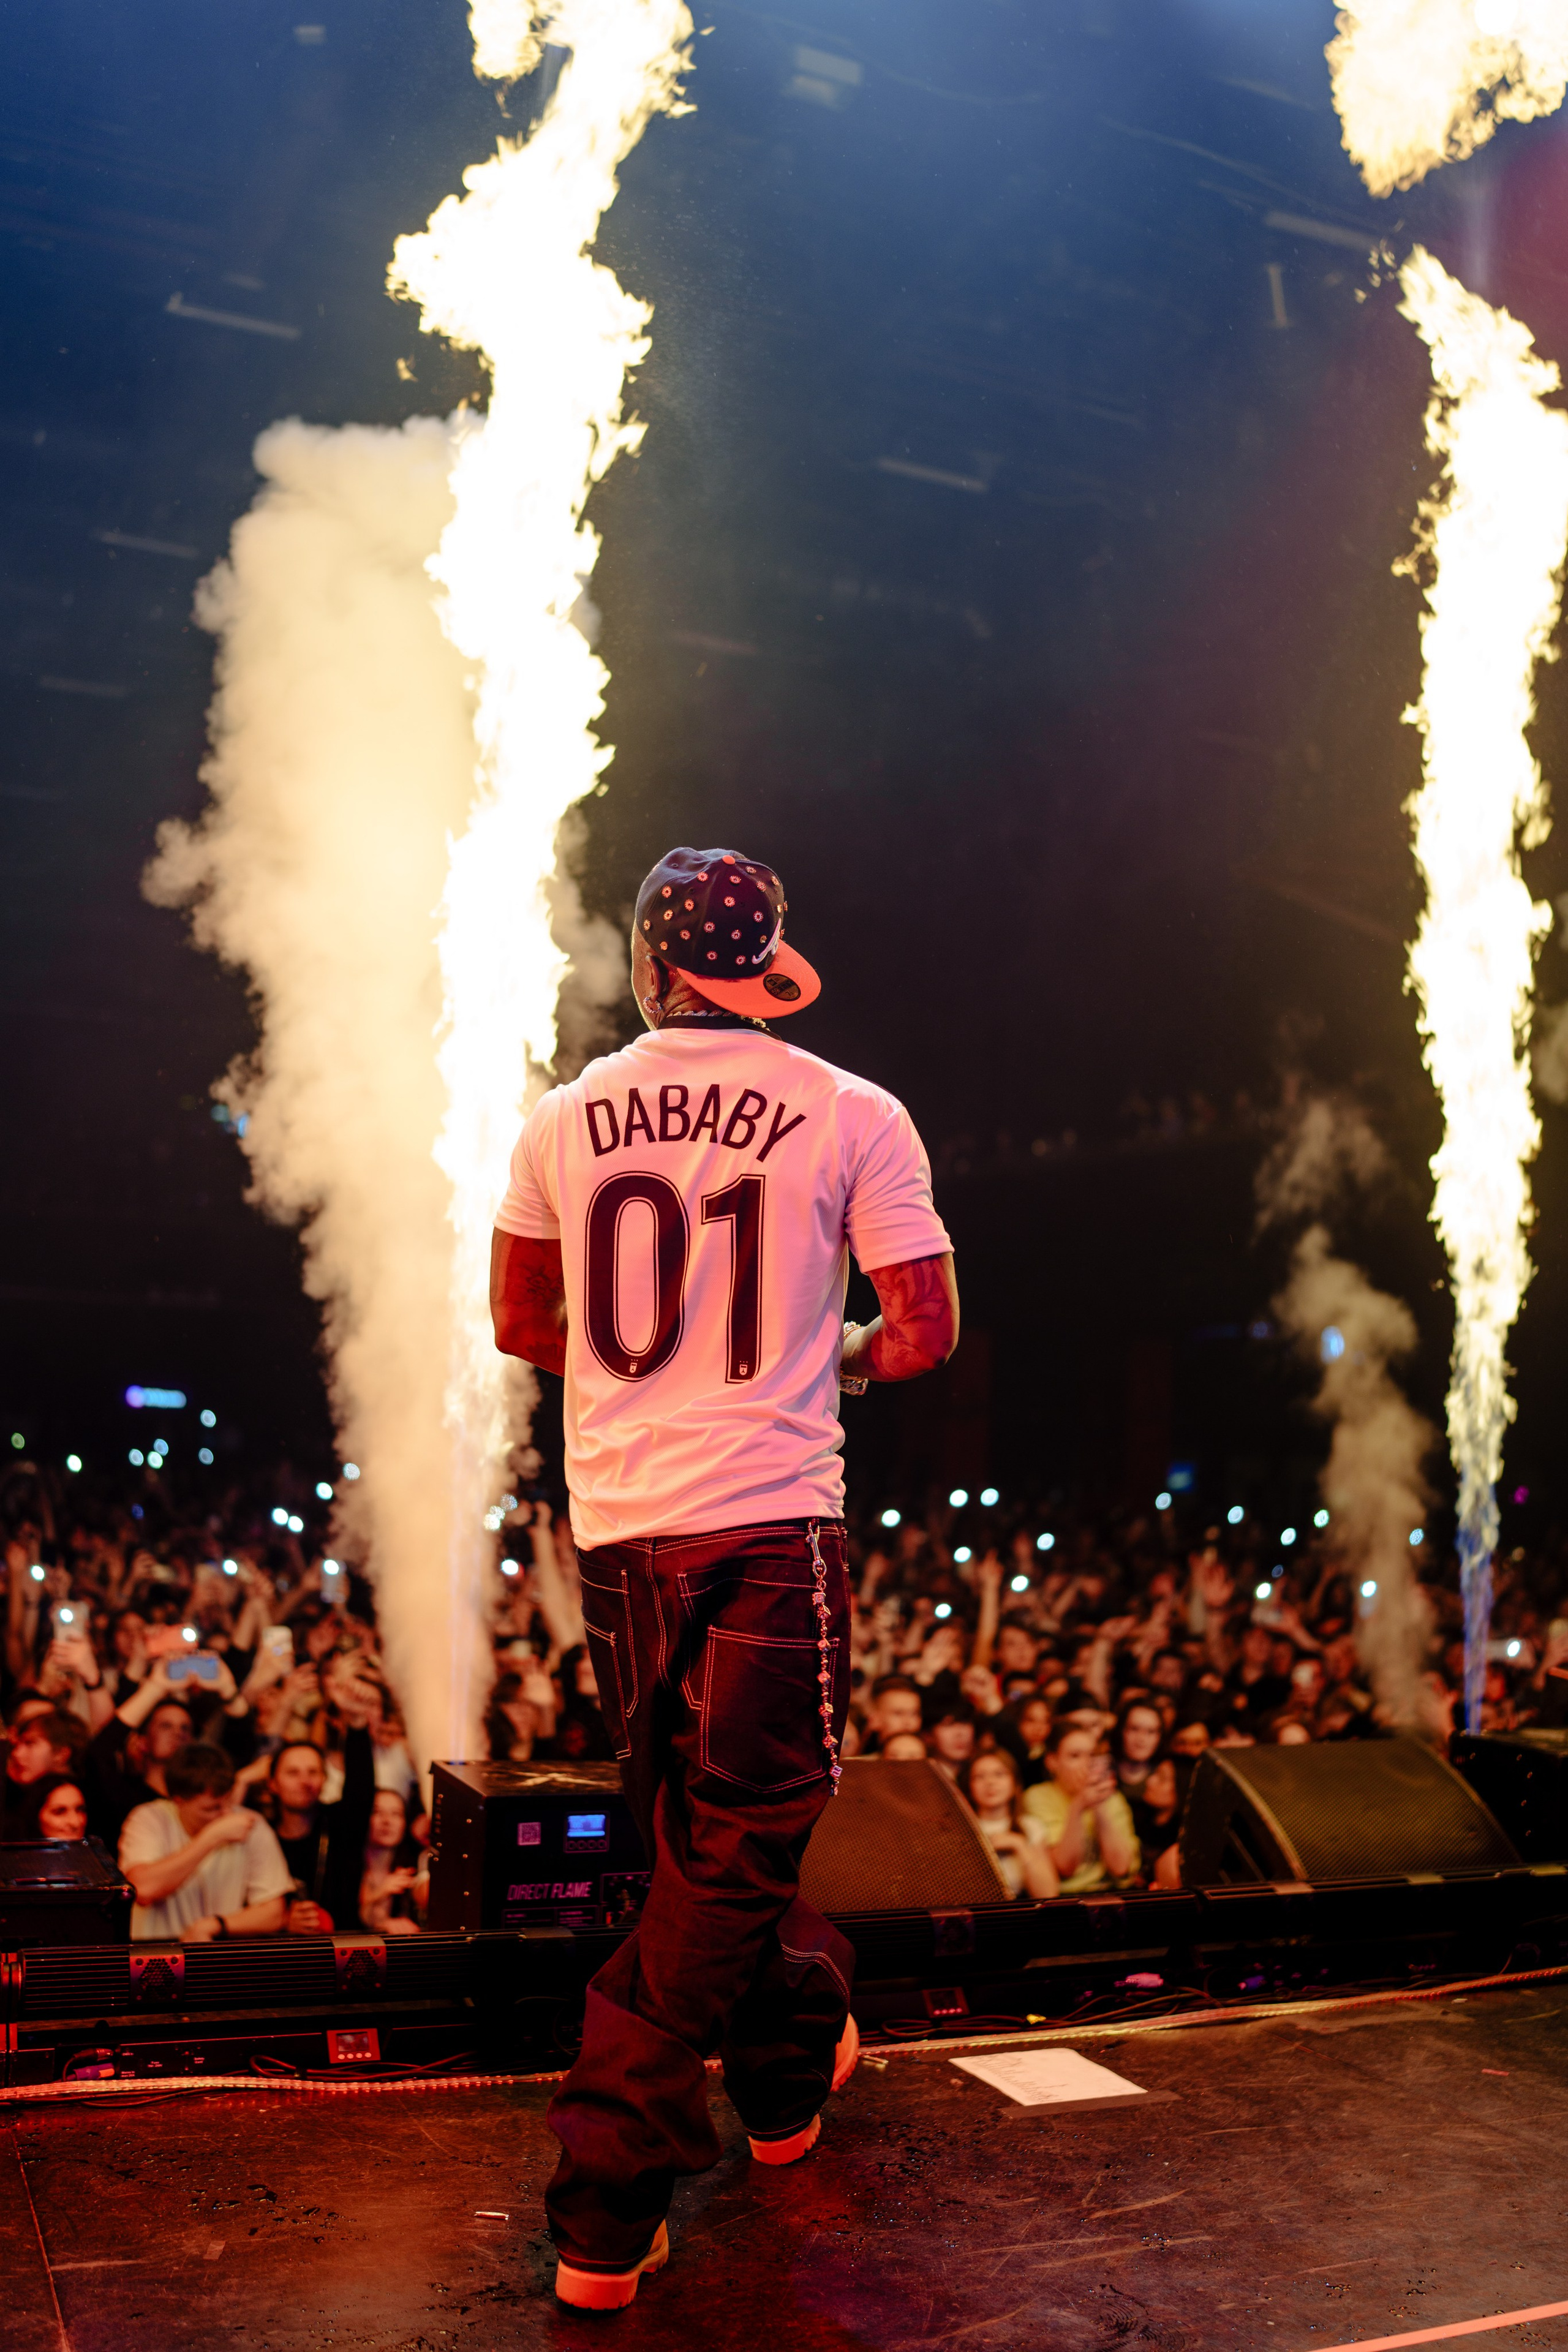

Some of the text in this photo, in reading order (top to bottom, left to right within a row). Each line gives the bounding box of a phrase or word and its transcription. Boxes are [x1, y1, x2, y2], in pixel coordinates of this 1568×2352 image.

[586, 1084, 807, 1163] DABABY
[584, 1171, 766, 1384] 01
[507, 1882, 593, 1900] DIRECT FLAME
